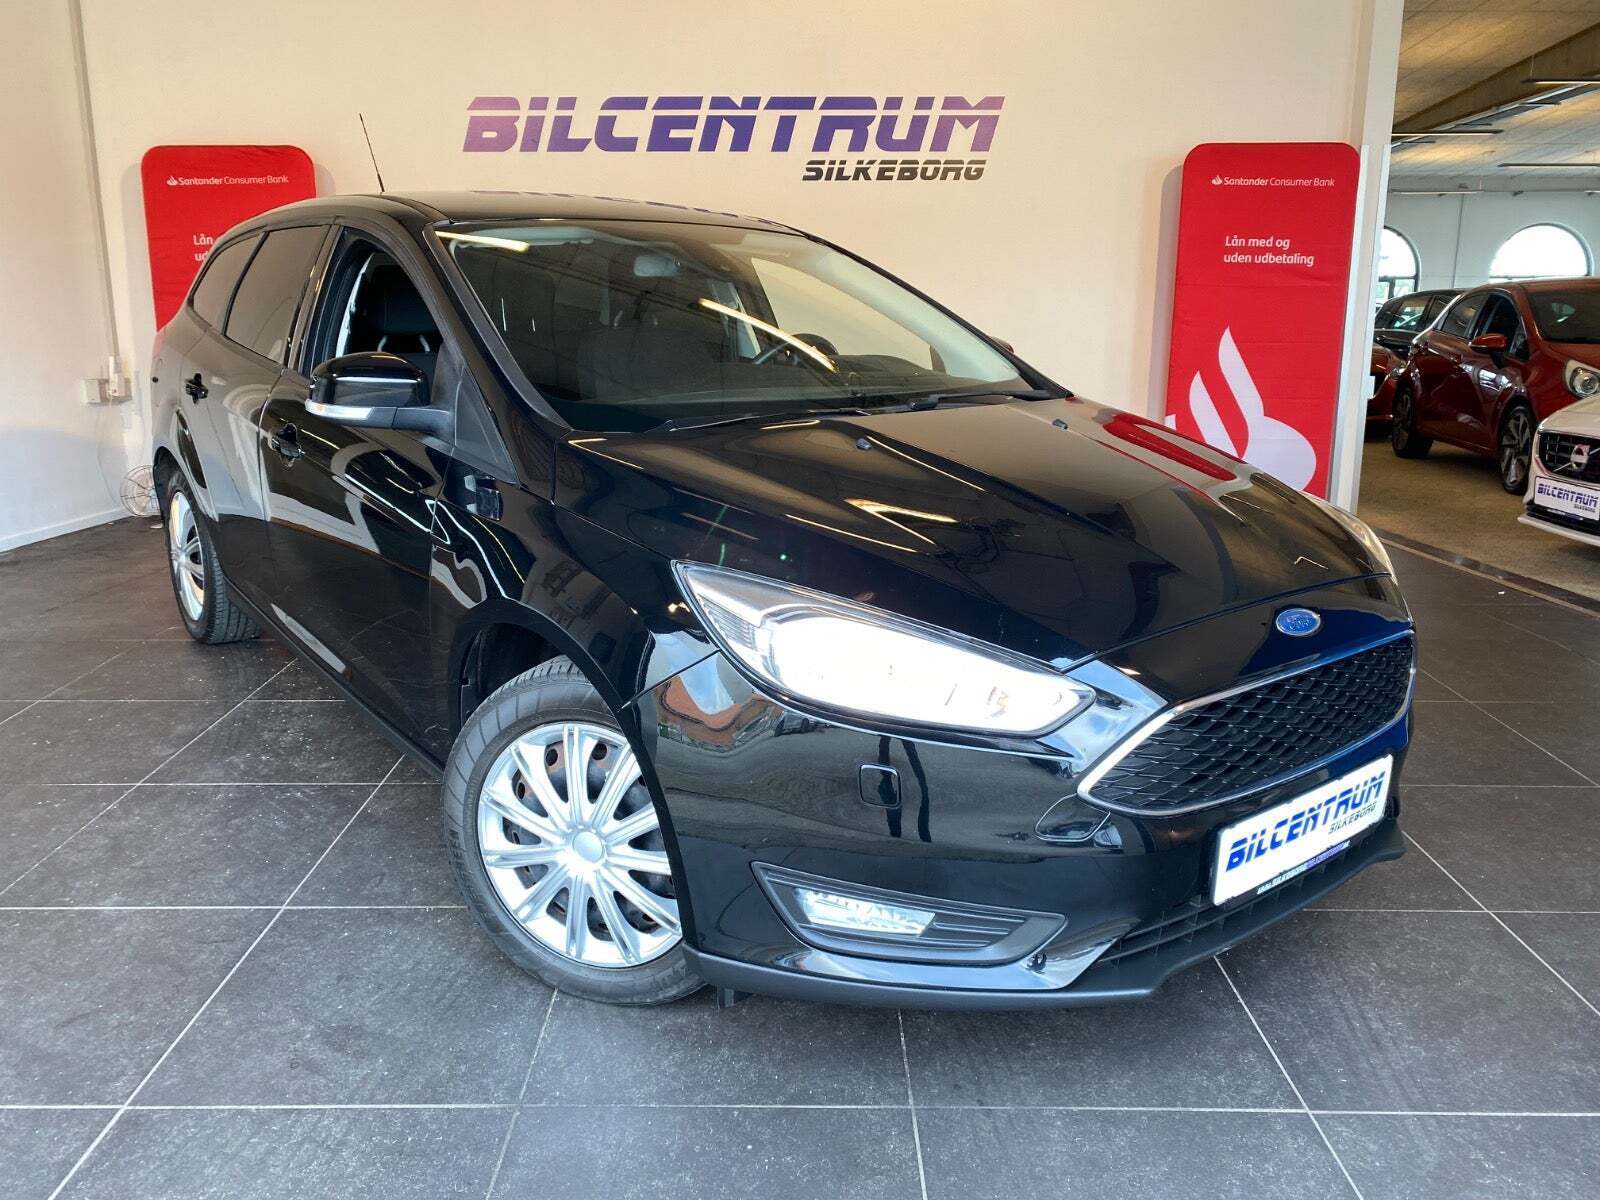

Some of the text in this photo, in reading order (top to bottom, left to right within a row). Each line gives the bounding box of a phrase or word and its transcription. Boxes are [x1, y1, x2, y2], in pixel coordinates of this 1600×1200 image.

[462, 96, 1006, 153] BILCENTRUM
[802, 159, 988, 181] SILKEBORG
[178, 175, 289, 186] Santander Consumer Bank
[1224, 176, 1335, 187] Santander Consumer Bank
[193, 233, 213, 245] Lån
[1225, 234, 1290, 250] Lån med og
[1224, 252, 1314, 267] uden udbetaling
[1537, 483, 1599, 508] BILCENTRUM
[1225, 770, 1386, 873] BILCENTRUM
